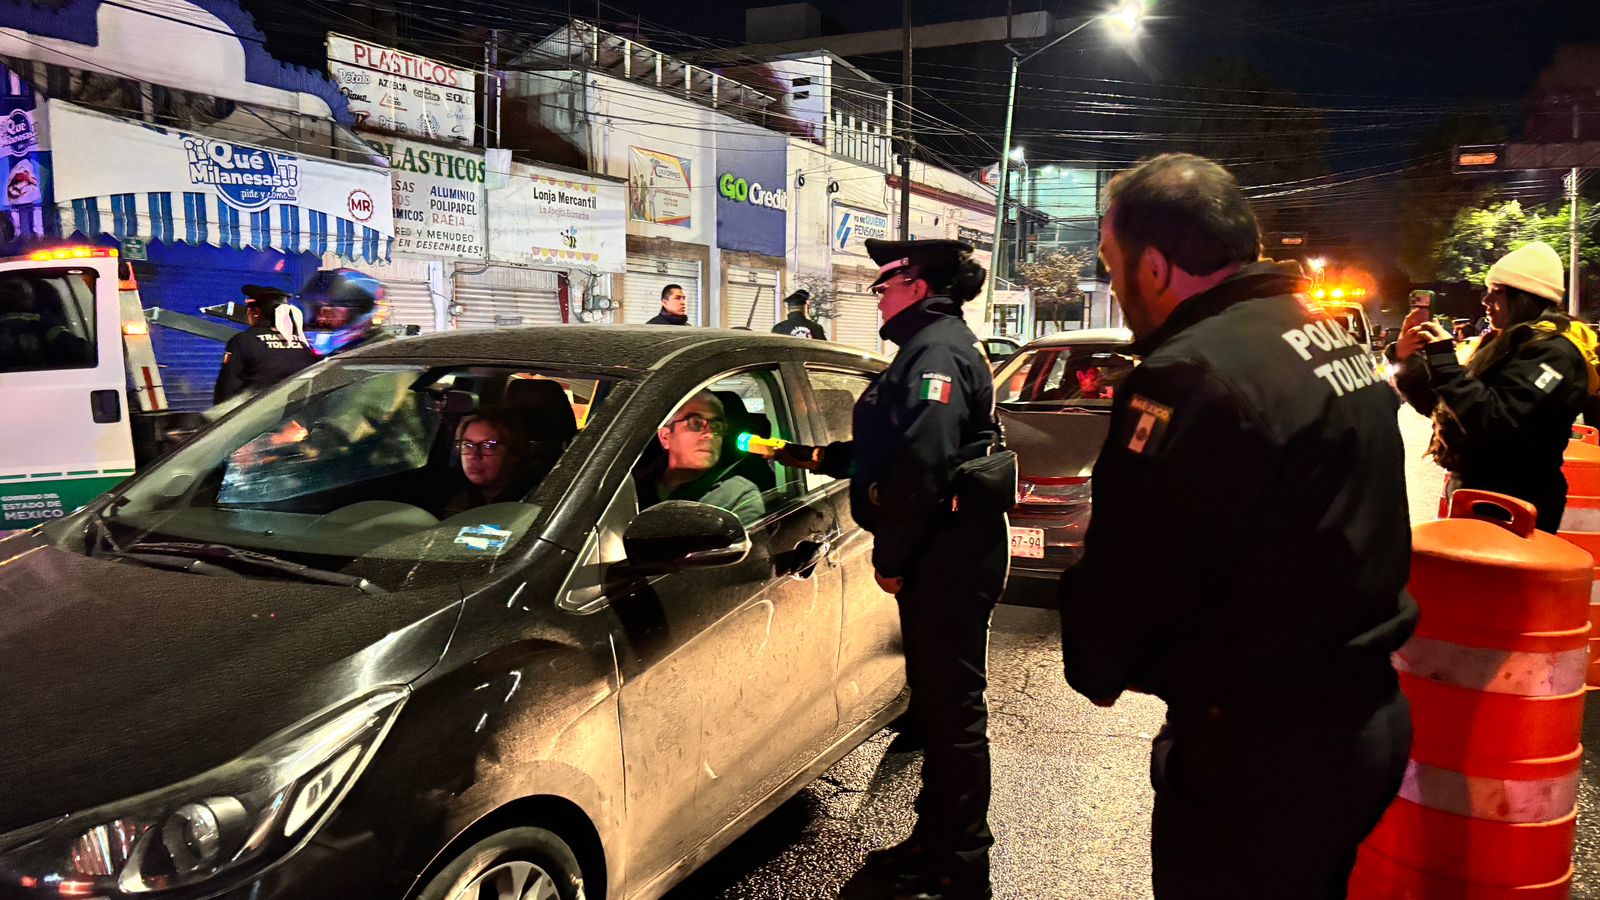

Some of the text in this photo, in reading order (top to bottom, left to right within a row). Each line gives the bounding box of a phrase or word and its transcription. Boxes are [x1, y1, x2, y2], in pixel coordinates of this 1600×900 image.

[353, 43, 458, 87] PLASTICOS
[189, 159, 297, 188] Milanesas!!
[241, 187, 259, 200] pide
[391, 180, 415, 193] SAS
[430, 186, 475, 202] ALUMINIO
[350, 198, 371, 212] MR
[533, 187, 597, 209] Lonja Mercantil
[430, 199, 478, 215] POLIPAPEL
[416, 229, 423, 237] Y
[427, 229, 474, 243] MENUDEO
[398, 239, 483, 256] EN DESECHABLES!
[2, 500, 62, 510] ESTADO DE
